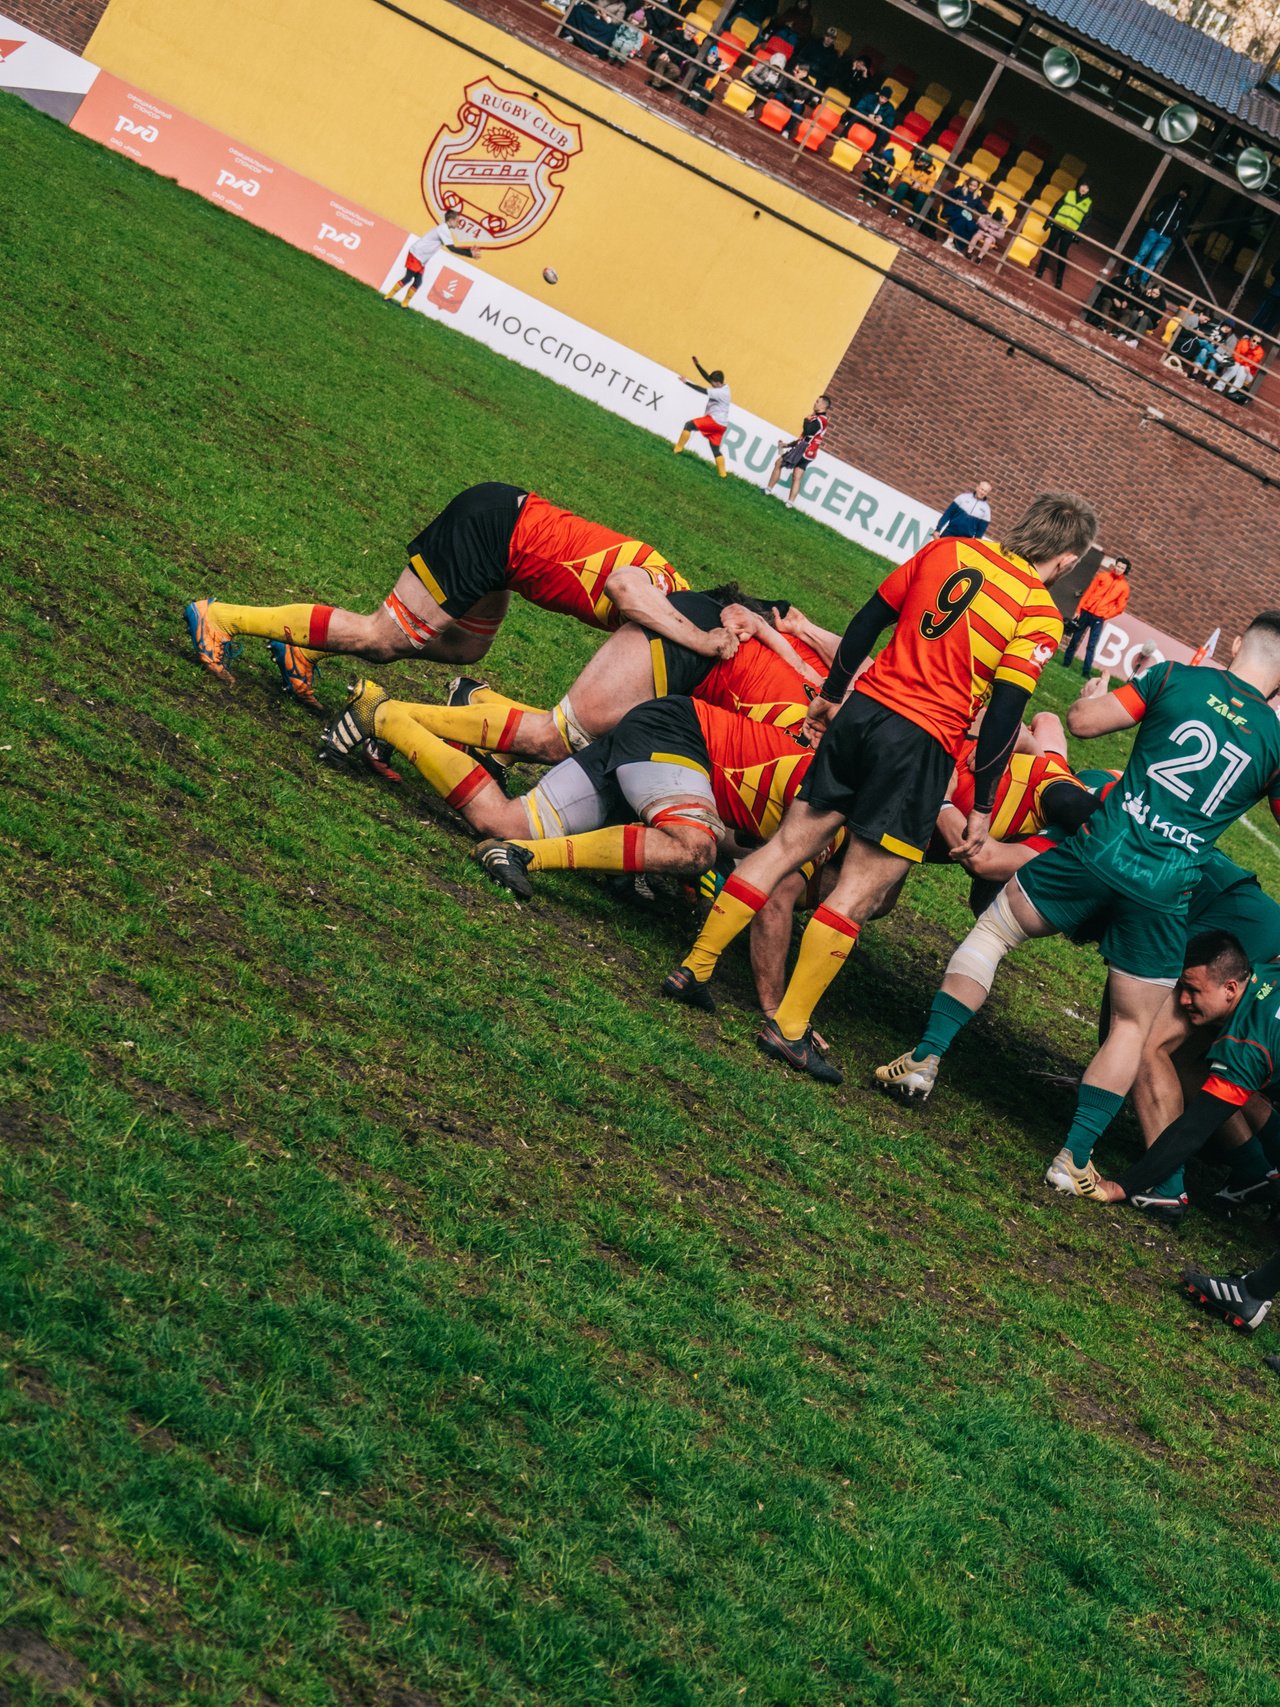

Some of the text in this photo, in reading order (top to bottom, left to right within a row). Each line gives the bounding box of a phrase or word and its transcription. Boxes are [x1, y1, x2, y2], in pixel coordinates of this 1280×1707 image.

[133, 103, 161, 120] СПОНСОР
[481, 94, 569, 148] RUGBY CLUB
[234, 157, 262, 174] СПОНСОР
[335, 210, 363, 227] СПОНСОР
[457, 218, 482, 239] 974
[478, 304, 665, 412] МОССПОРТТЕХ
[722, 421, 935, 554] RUGER.IN
[919, 566, 986, 641] 9
[1146, 720, 1252, 818] 21
